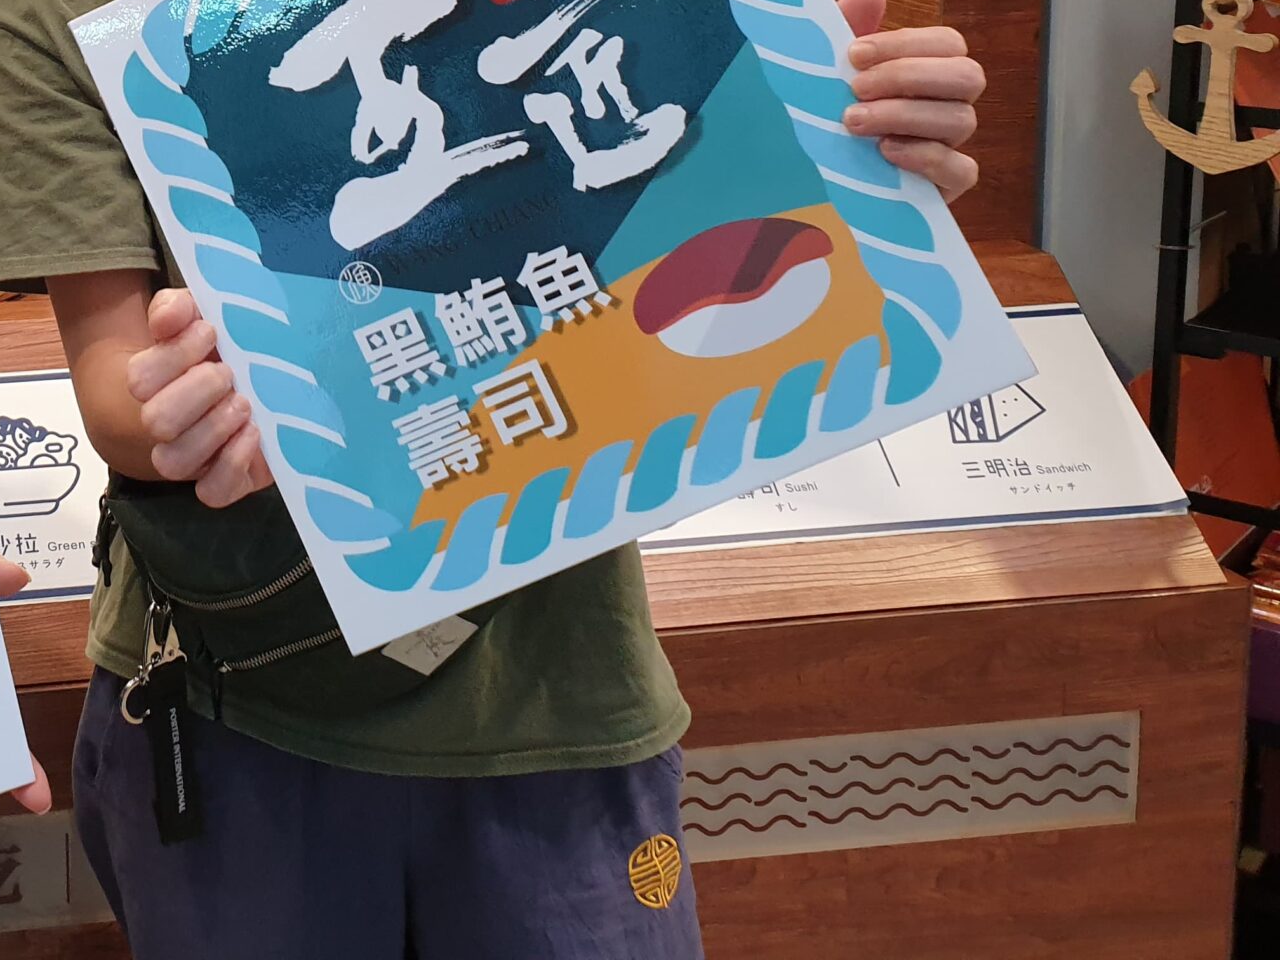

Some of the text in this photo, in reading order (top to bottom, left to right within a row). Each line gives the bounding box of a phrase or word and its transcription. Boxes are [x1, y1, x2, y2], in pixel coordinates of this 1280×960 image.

[353, 245, 612, 401] 黑鮪魚
[391, 359, 568, 489] 壽司
[961, 457, 1092, 479] 三明治 Sandwich
[785, 481, 818, 493] Sushi
[1009, 481, 1076, 495] サンドイッチ
[775, 501, 798, 512] すし
[47, 541, 86, 552] Green
[169, 707, 186, 813] PORTER INTERNATIONAL
